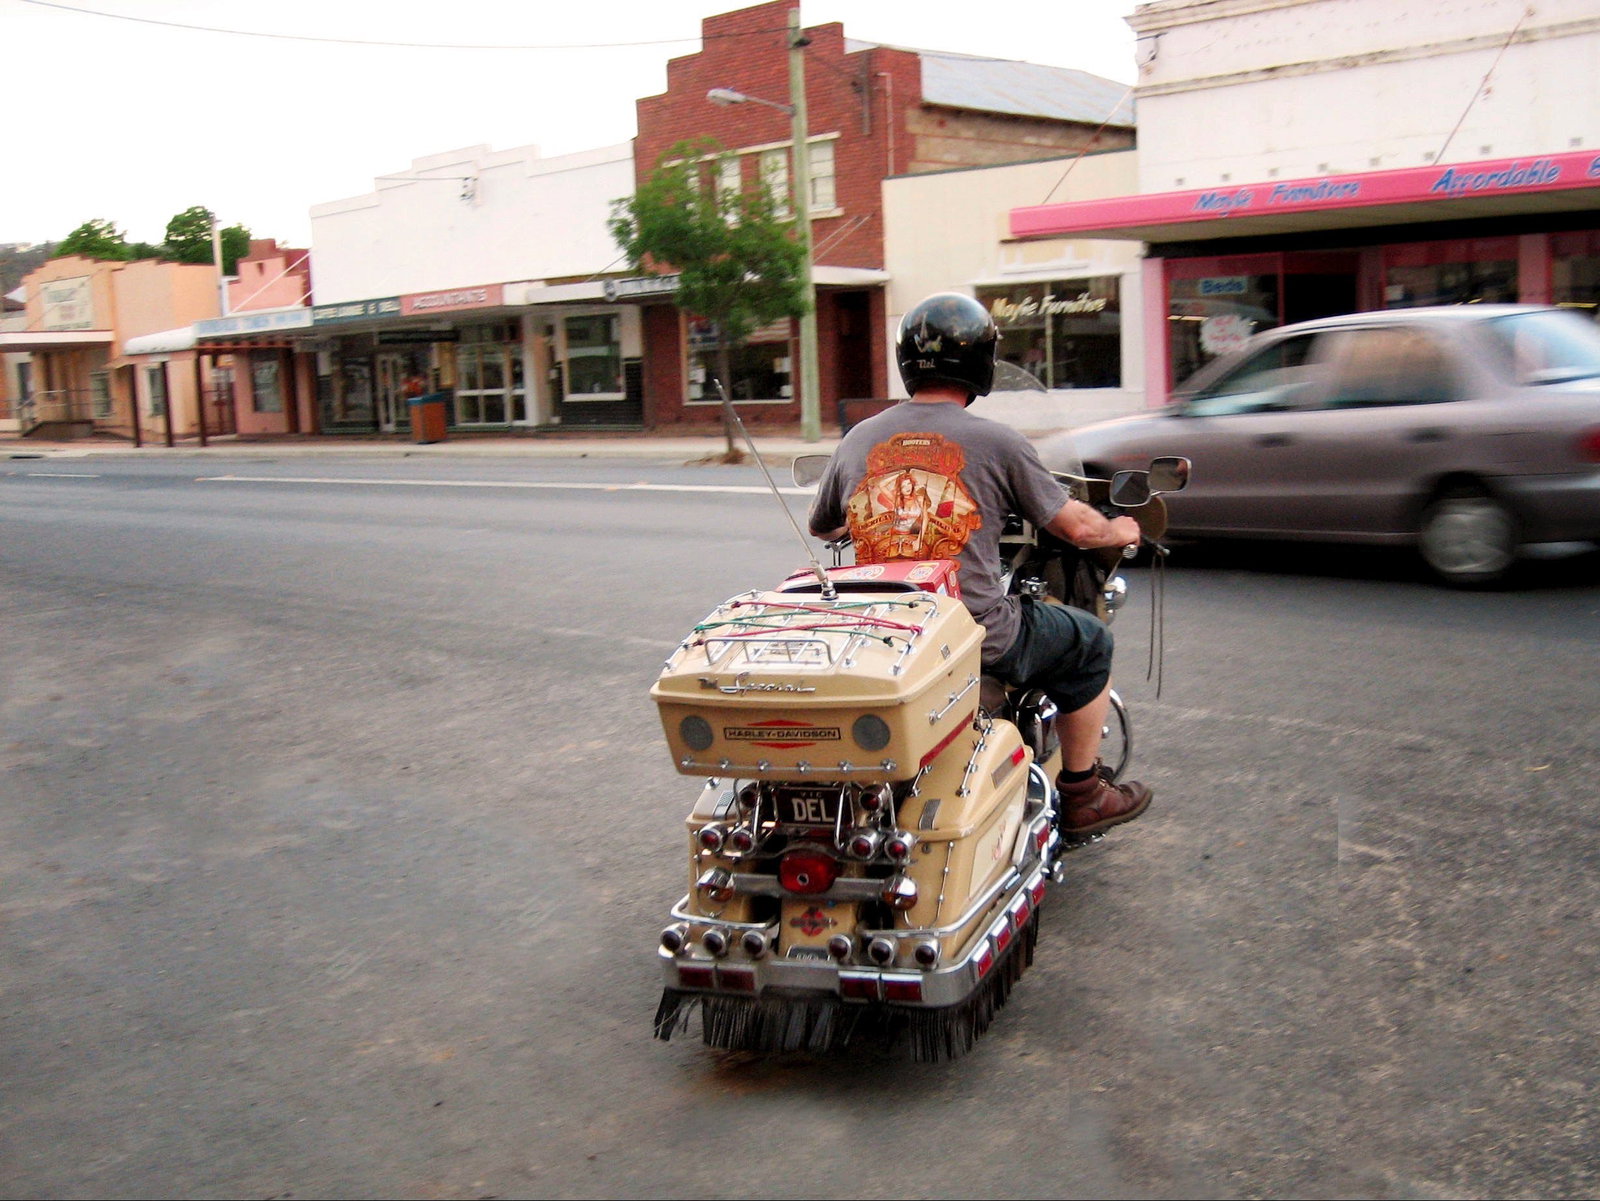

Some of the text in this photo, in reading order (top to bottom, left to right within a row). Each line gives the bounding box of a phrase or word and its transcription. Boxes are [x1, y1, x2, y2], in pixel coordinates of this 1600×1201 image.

[1431, 158, 1561, 198] Affordable
[902, 439, 931, 447] HOOTERS
[728, 729, 836, 739] HARLEY-DAVIDSON
[791, 798, 835, 822] DEL
